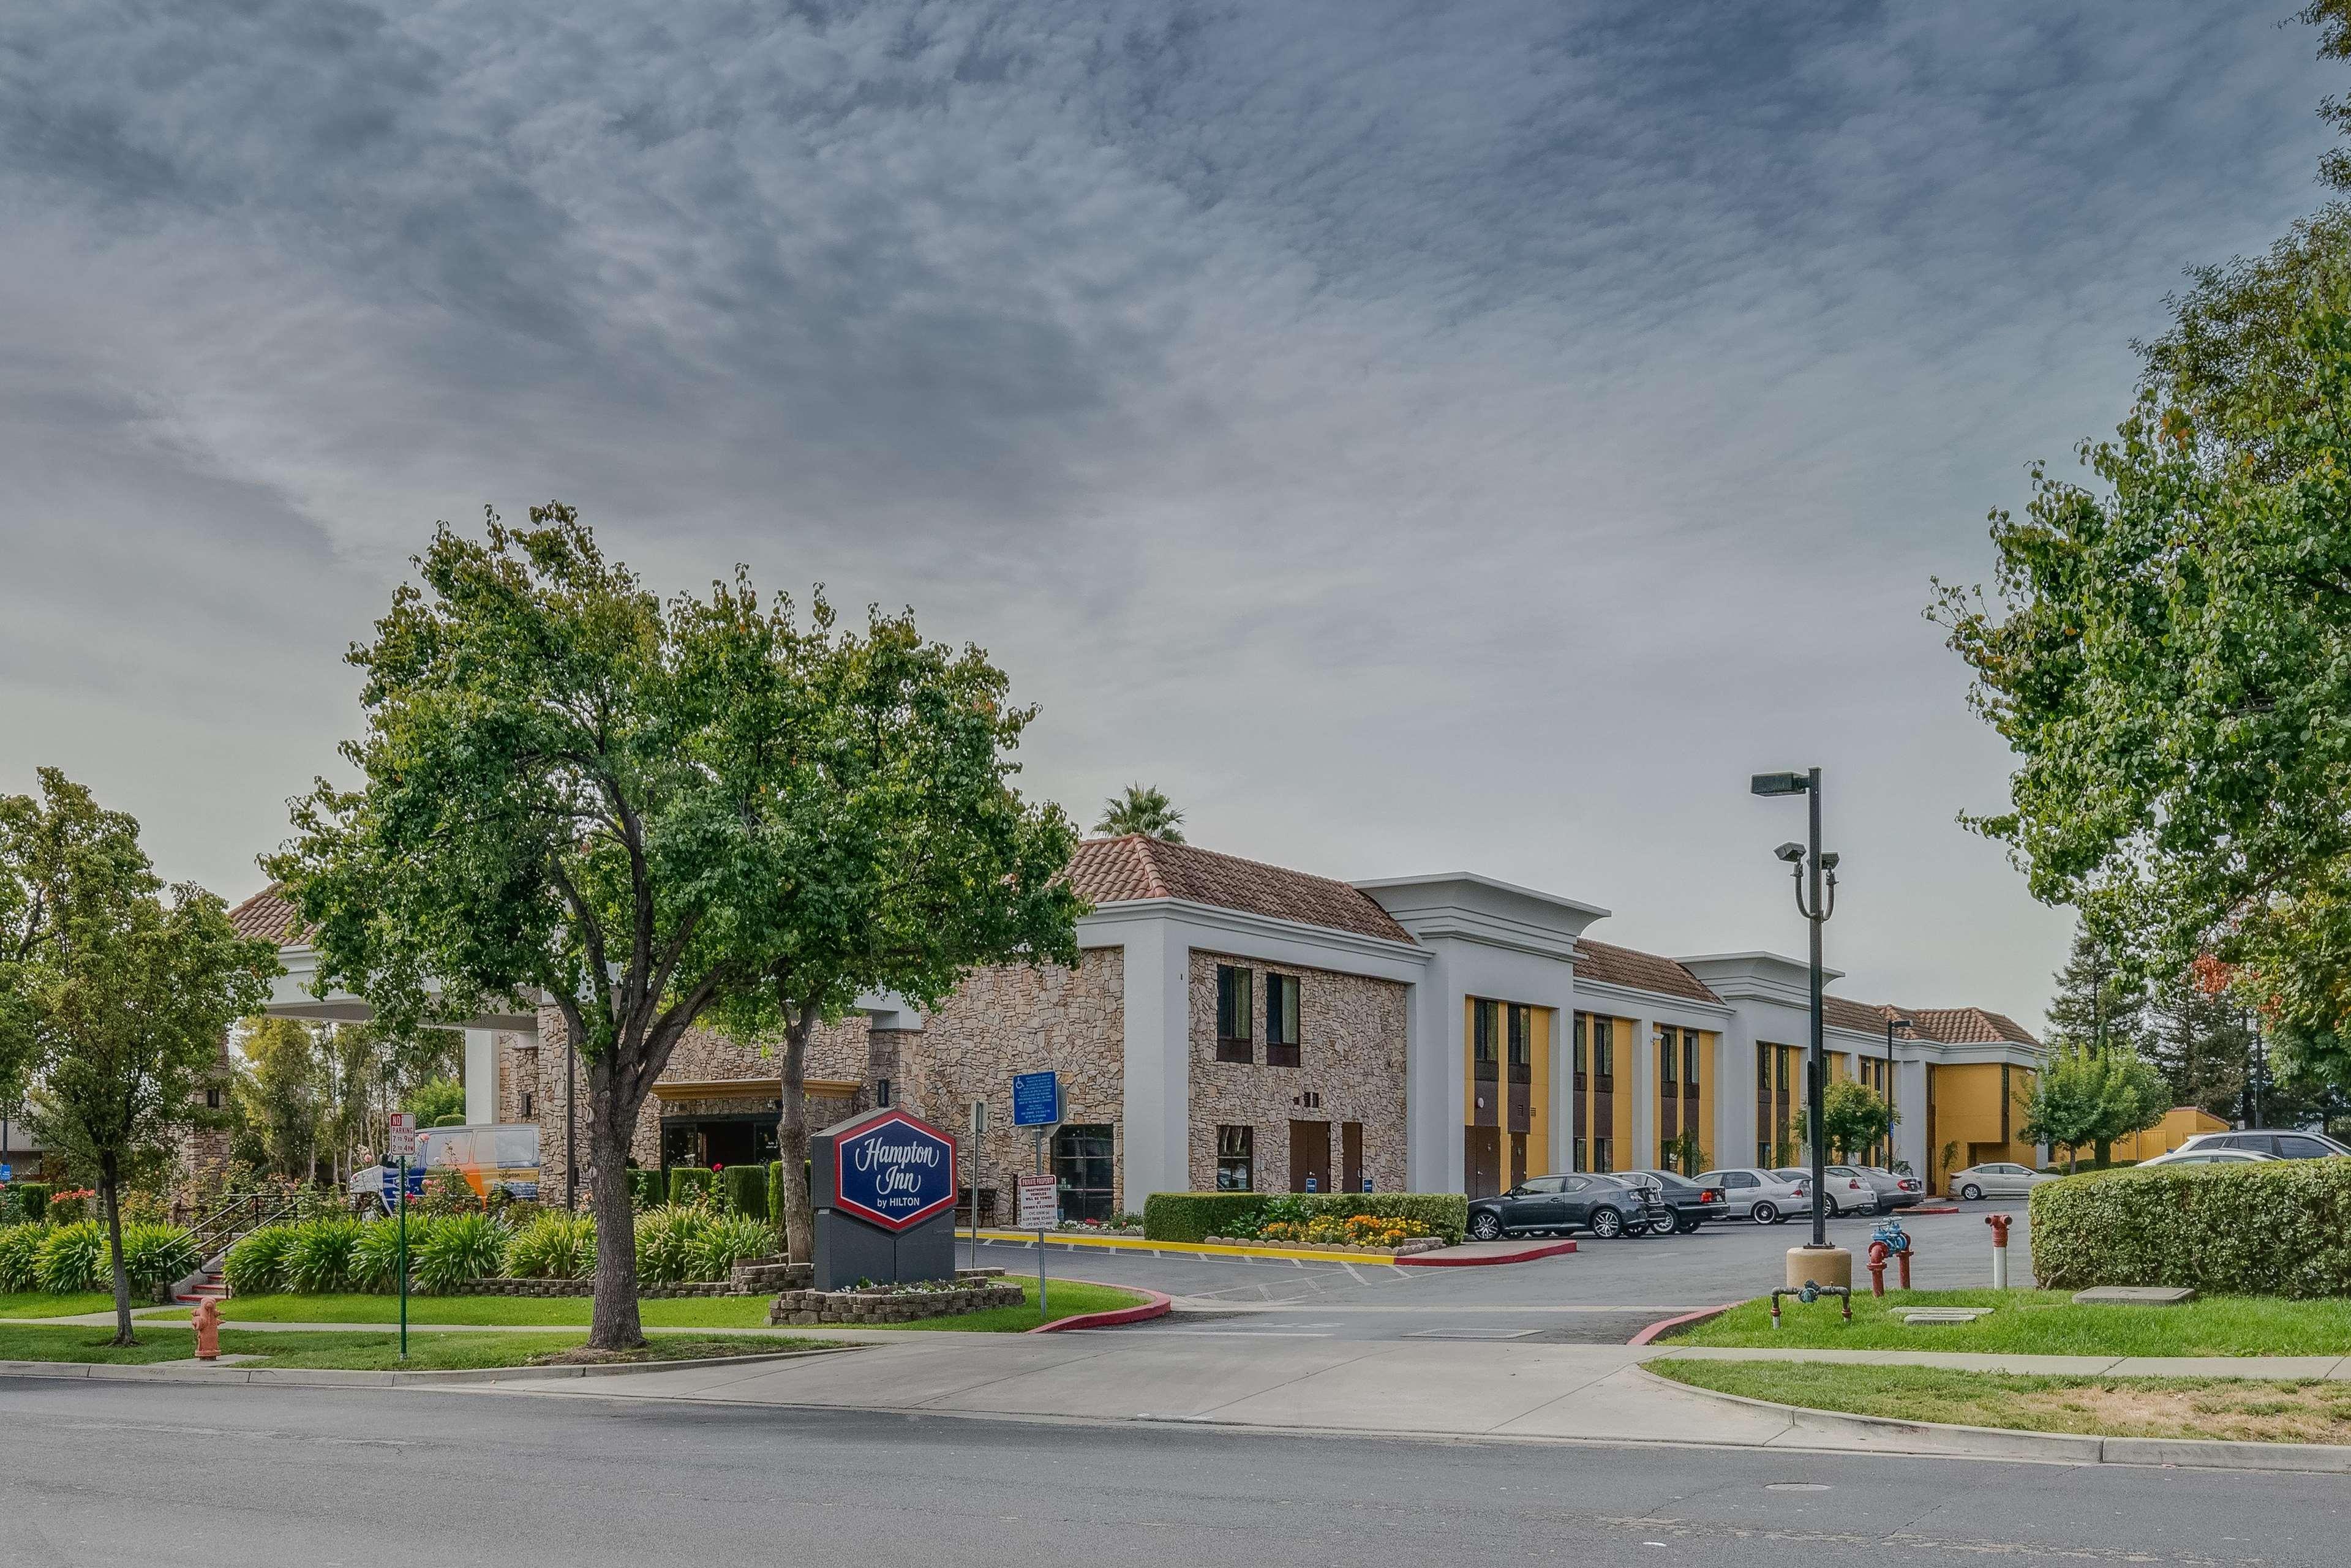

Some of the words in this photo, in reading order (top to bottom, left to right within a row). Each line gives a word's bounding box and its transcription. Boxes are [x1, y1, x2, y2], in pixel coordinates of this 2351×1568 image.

[393, 1116, 401, 1125] NO
[856, 1137, 939, 1171] Hampton
[876, 1165, 921, 1195] Inn
[877, 1198, 887, 1209] by
[890, 1198, 920, 1206] HILTON
